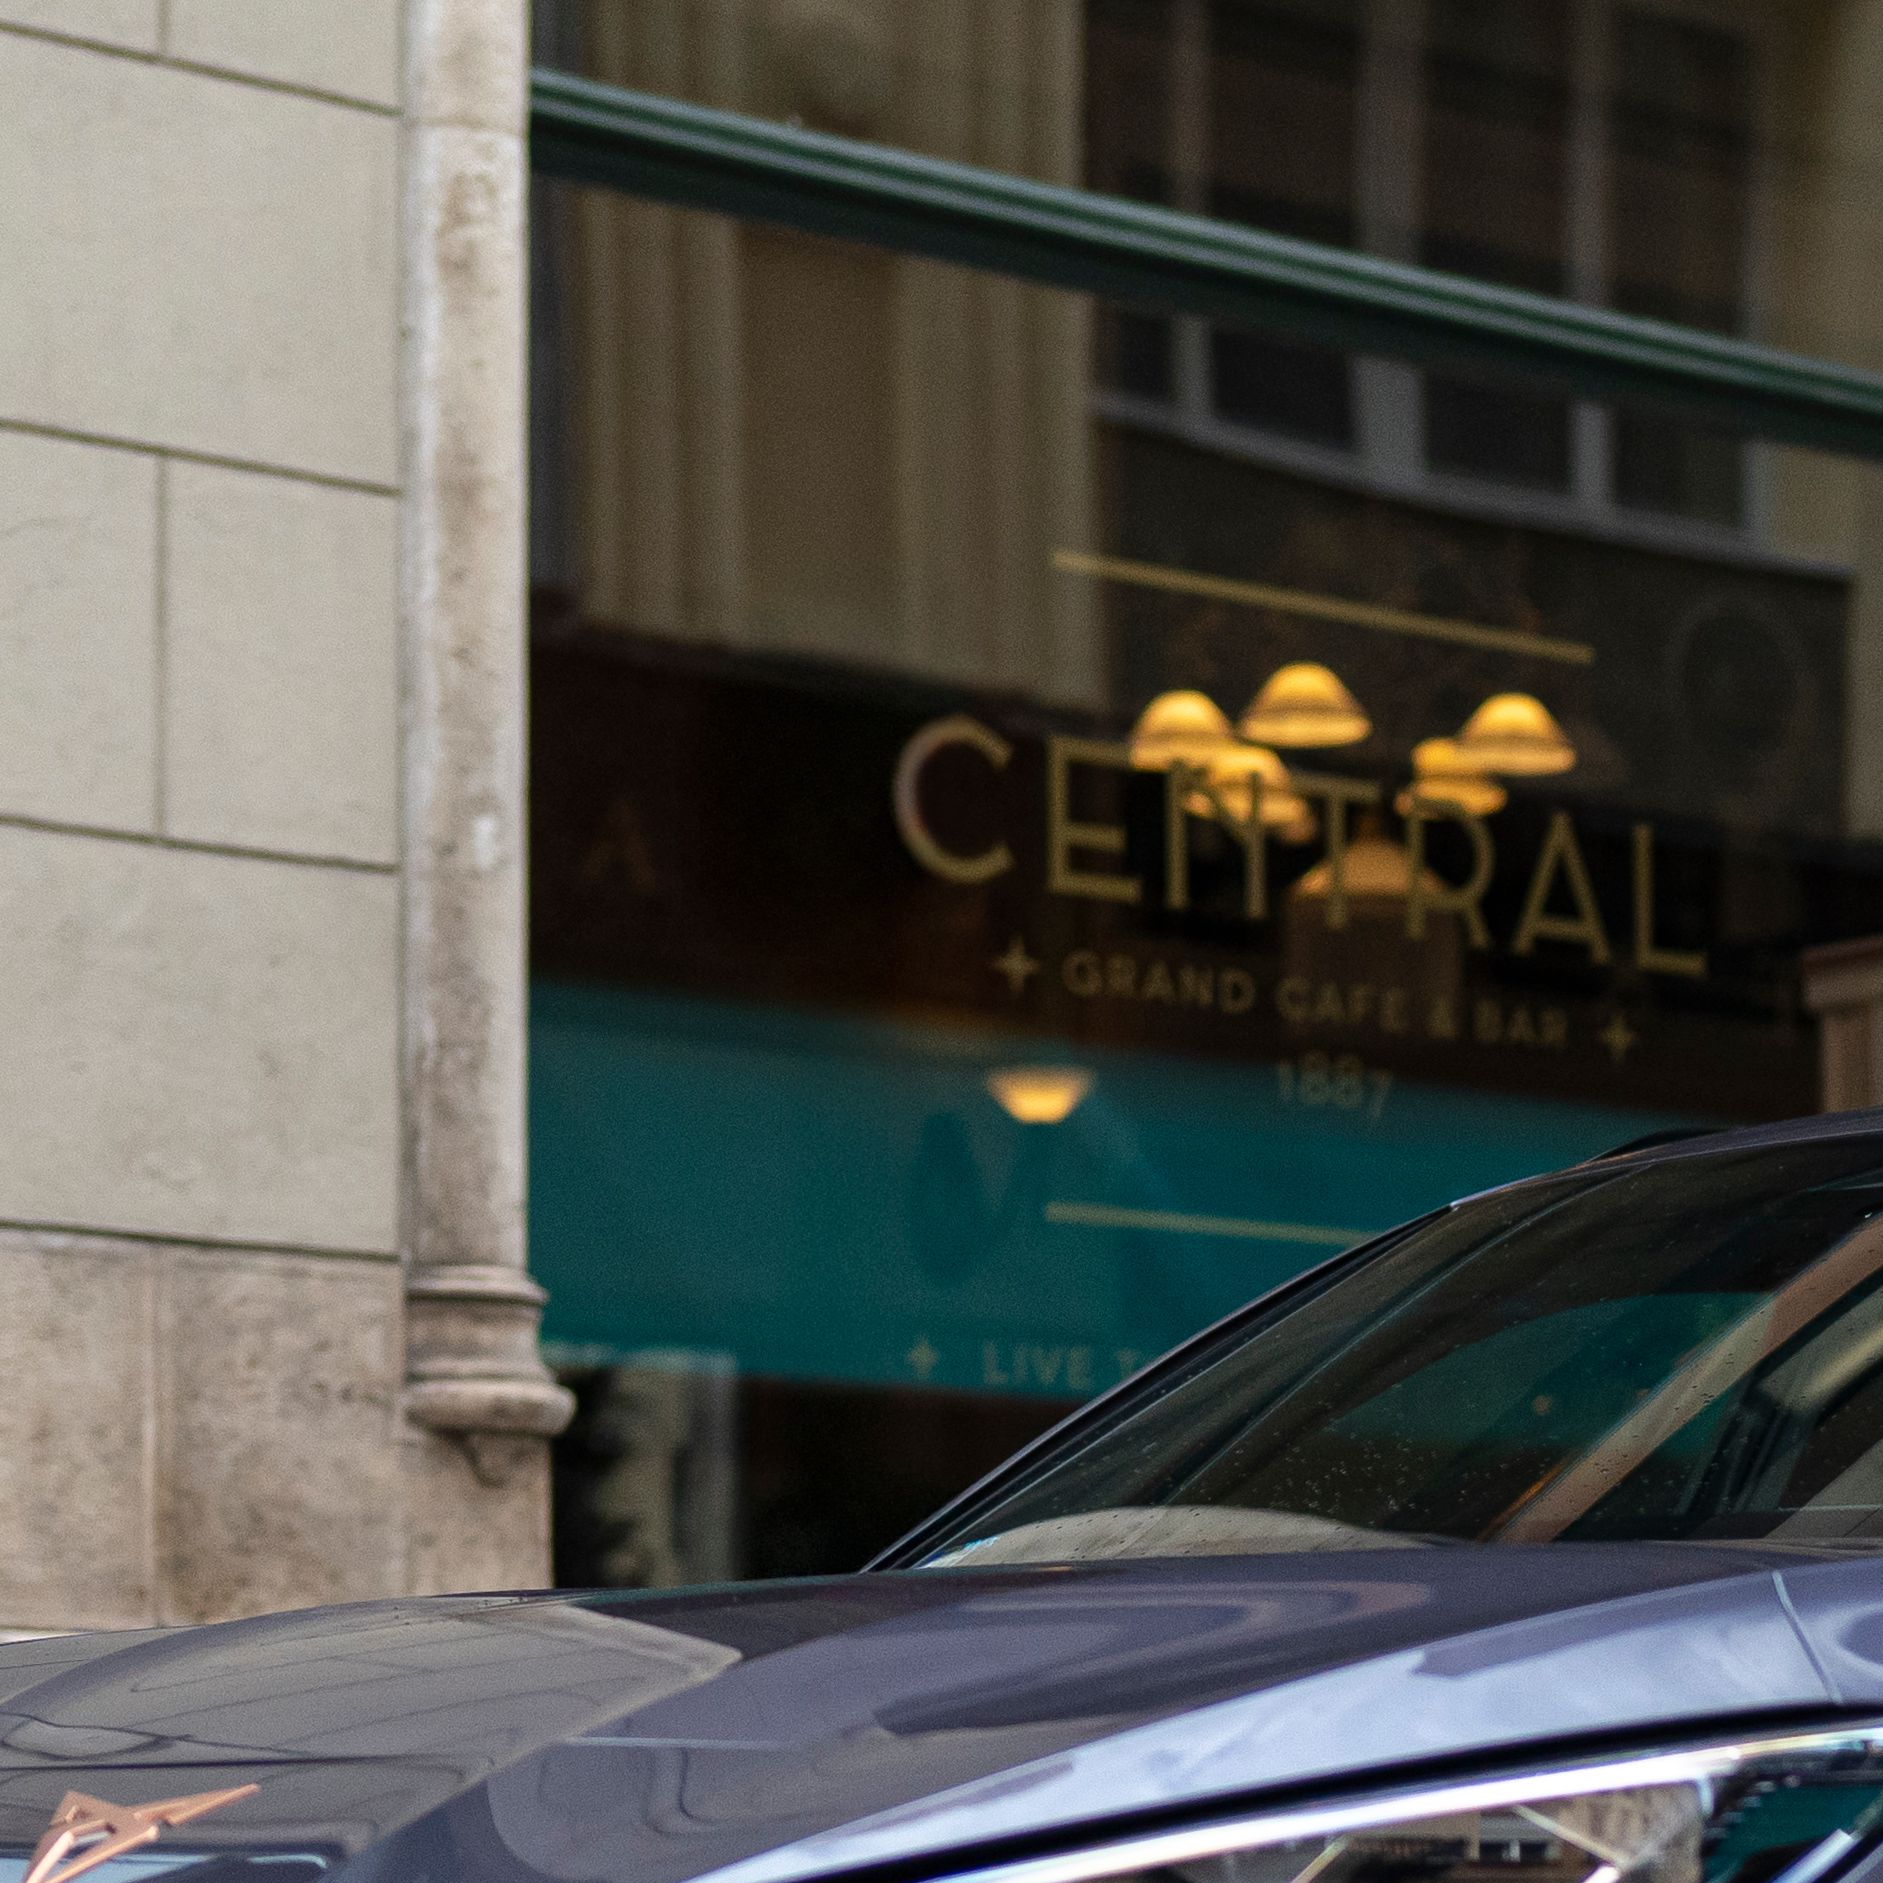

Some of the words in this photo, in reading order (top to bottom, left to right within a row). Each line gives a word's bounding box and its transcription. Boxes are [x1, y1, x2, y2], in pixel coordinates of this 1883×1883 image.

[891, 715, 1707, 975] CENTRAL
[1062, 950, 1256, 1013] GRAND
[1475, 1003, 1567, 1049] BAR
[1277, 1050, 1394, 1119] 1887
[982, 1340, 1093, 1388] LIVE
